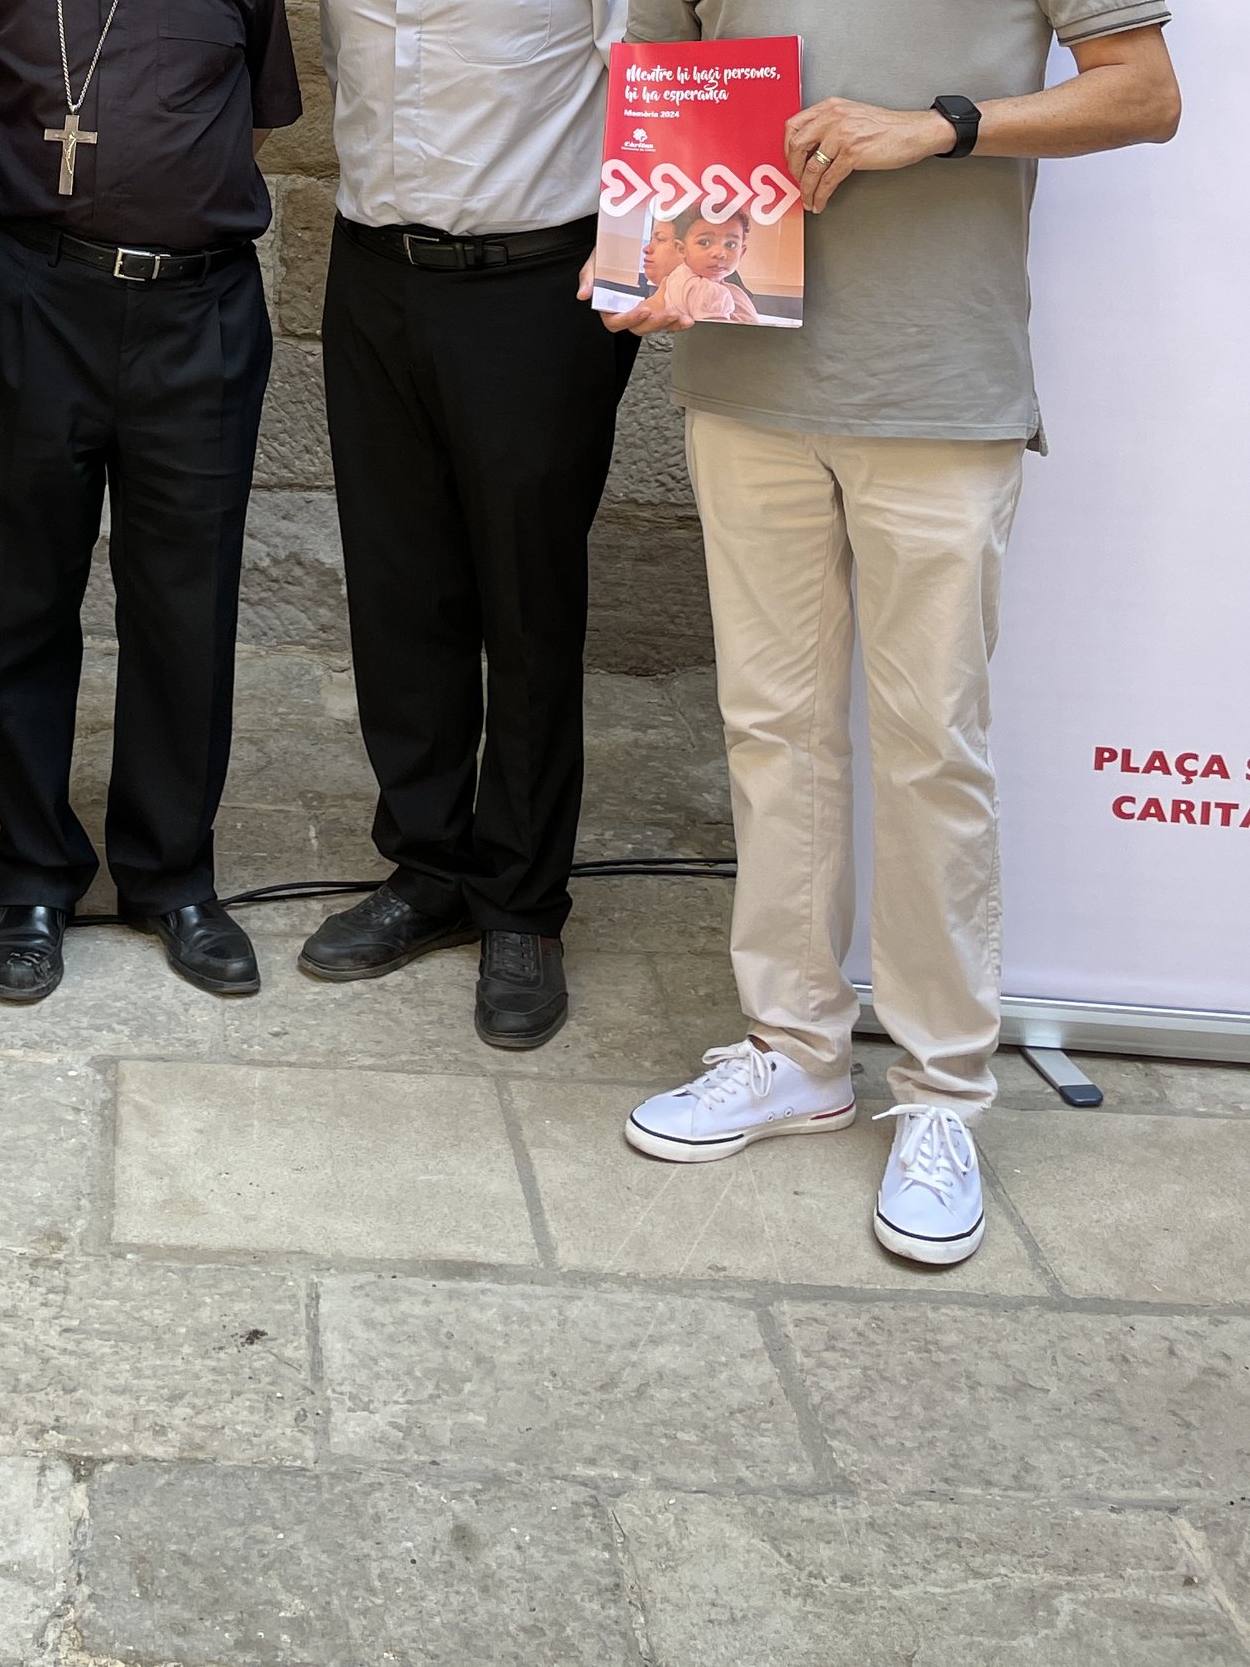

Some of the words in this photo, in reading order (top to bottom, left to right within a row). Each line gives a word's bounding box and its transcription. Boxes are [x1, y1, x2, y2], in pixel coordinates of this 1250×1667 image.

[626, 64, 674, 82] Mentre
[676, 66, 691, 84] hi
[693, 66, 721, 91] hagi
[723, 66, 781, 85] persones,
[624, 85, 639, 103] hi
[642, 86, 660, 104] ha
[663, 89, 729, 106] esperança
[660, 110, 680, 118] 2024
[1093, 746, 1231, 784] PLAÇA
